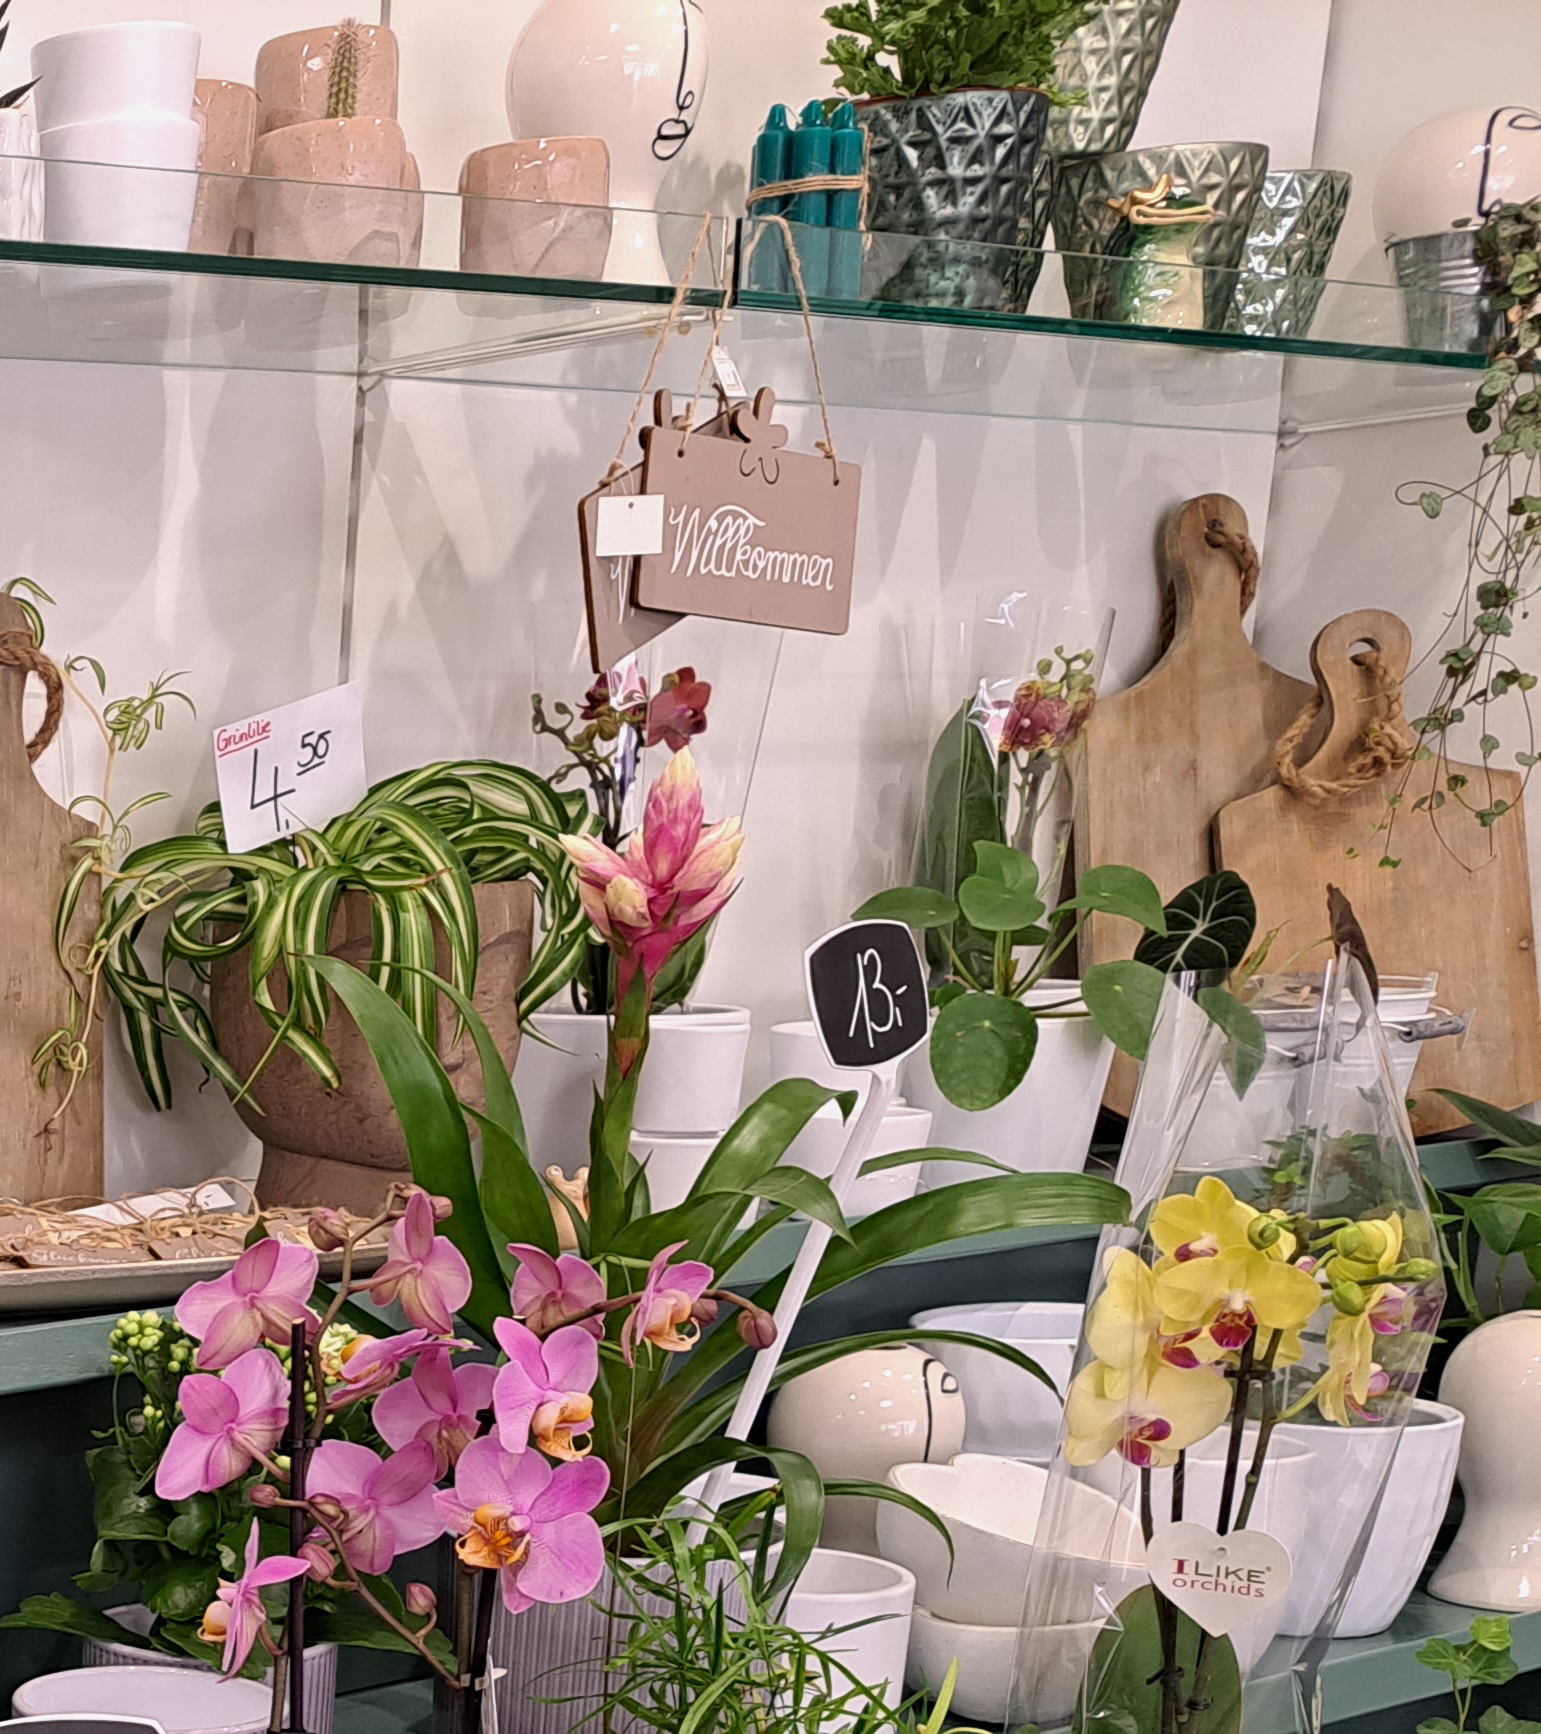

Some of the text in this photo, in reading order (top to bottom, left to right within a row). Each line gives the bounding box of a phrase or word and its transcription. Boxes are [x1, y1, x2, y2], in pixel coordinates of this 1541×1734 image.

[668, 504, 834, 591] Willkommen
[1171, 1557, 1190, 1576] I
[1171, 1577, 1266, 1598] orchids
